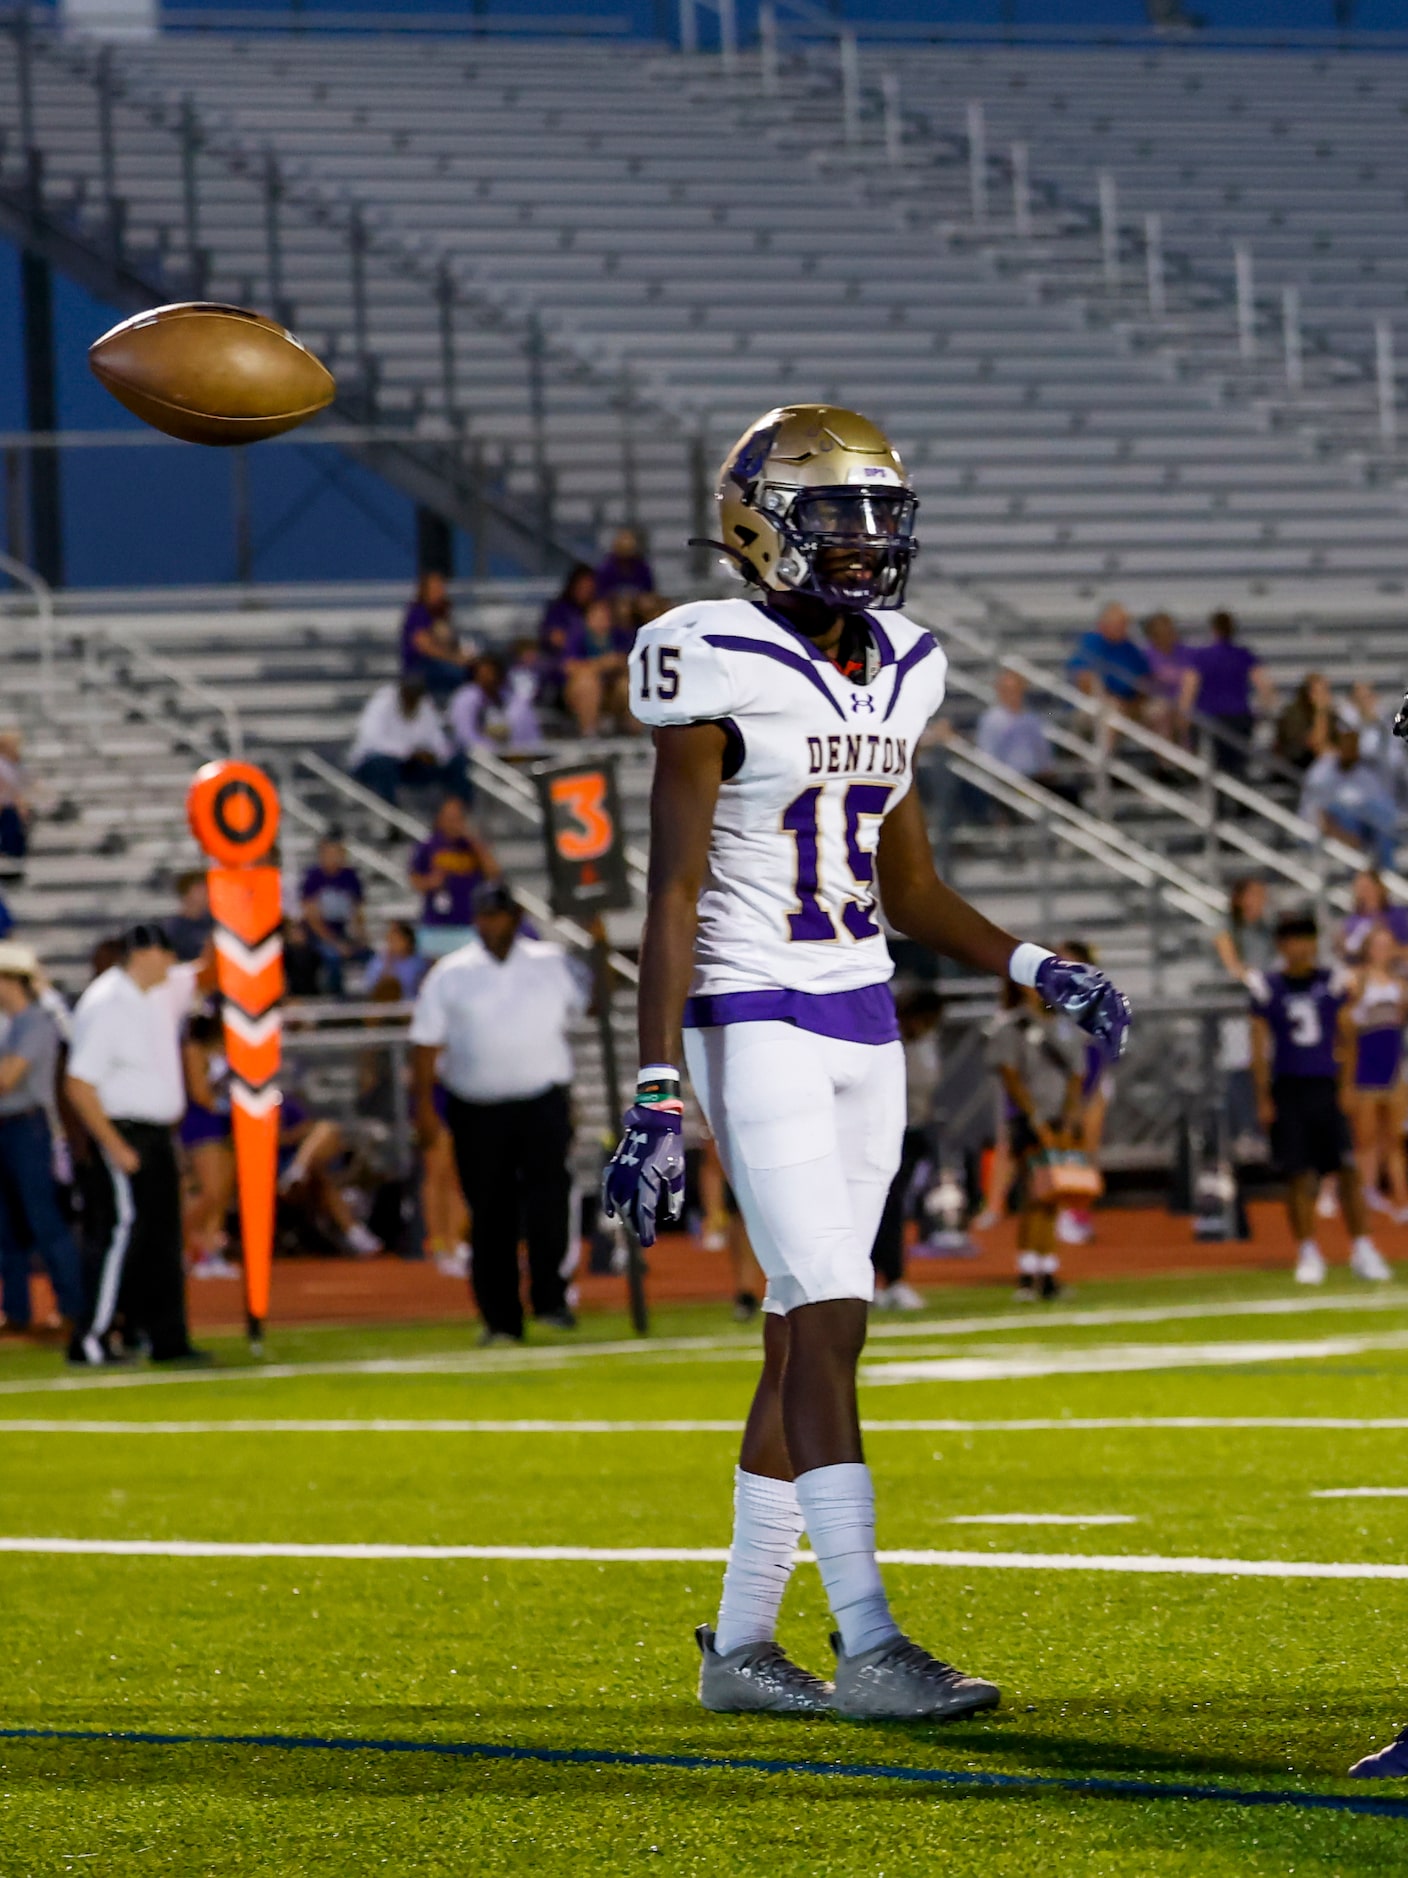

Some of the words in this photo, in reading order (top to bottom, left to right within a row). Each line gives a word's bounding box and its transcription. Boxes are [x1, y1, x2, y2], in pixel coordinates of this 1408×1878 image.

[639, 644, 682, 701] 15
[806, 733, 908, 776] DENTON
[549, 771, 613, 861] 3
[781, 781, 899, 945] 15
[1285, 997, 1323, 1047] 3
